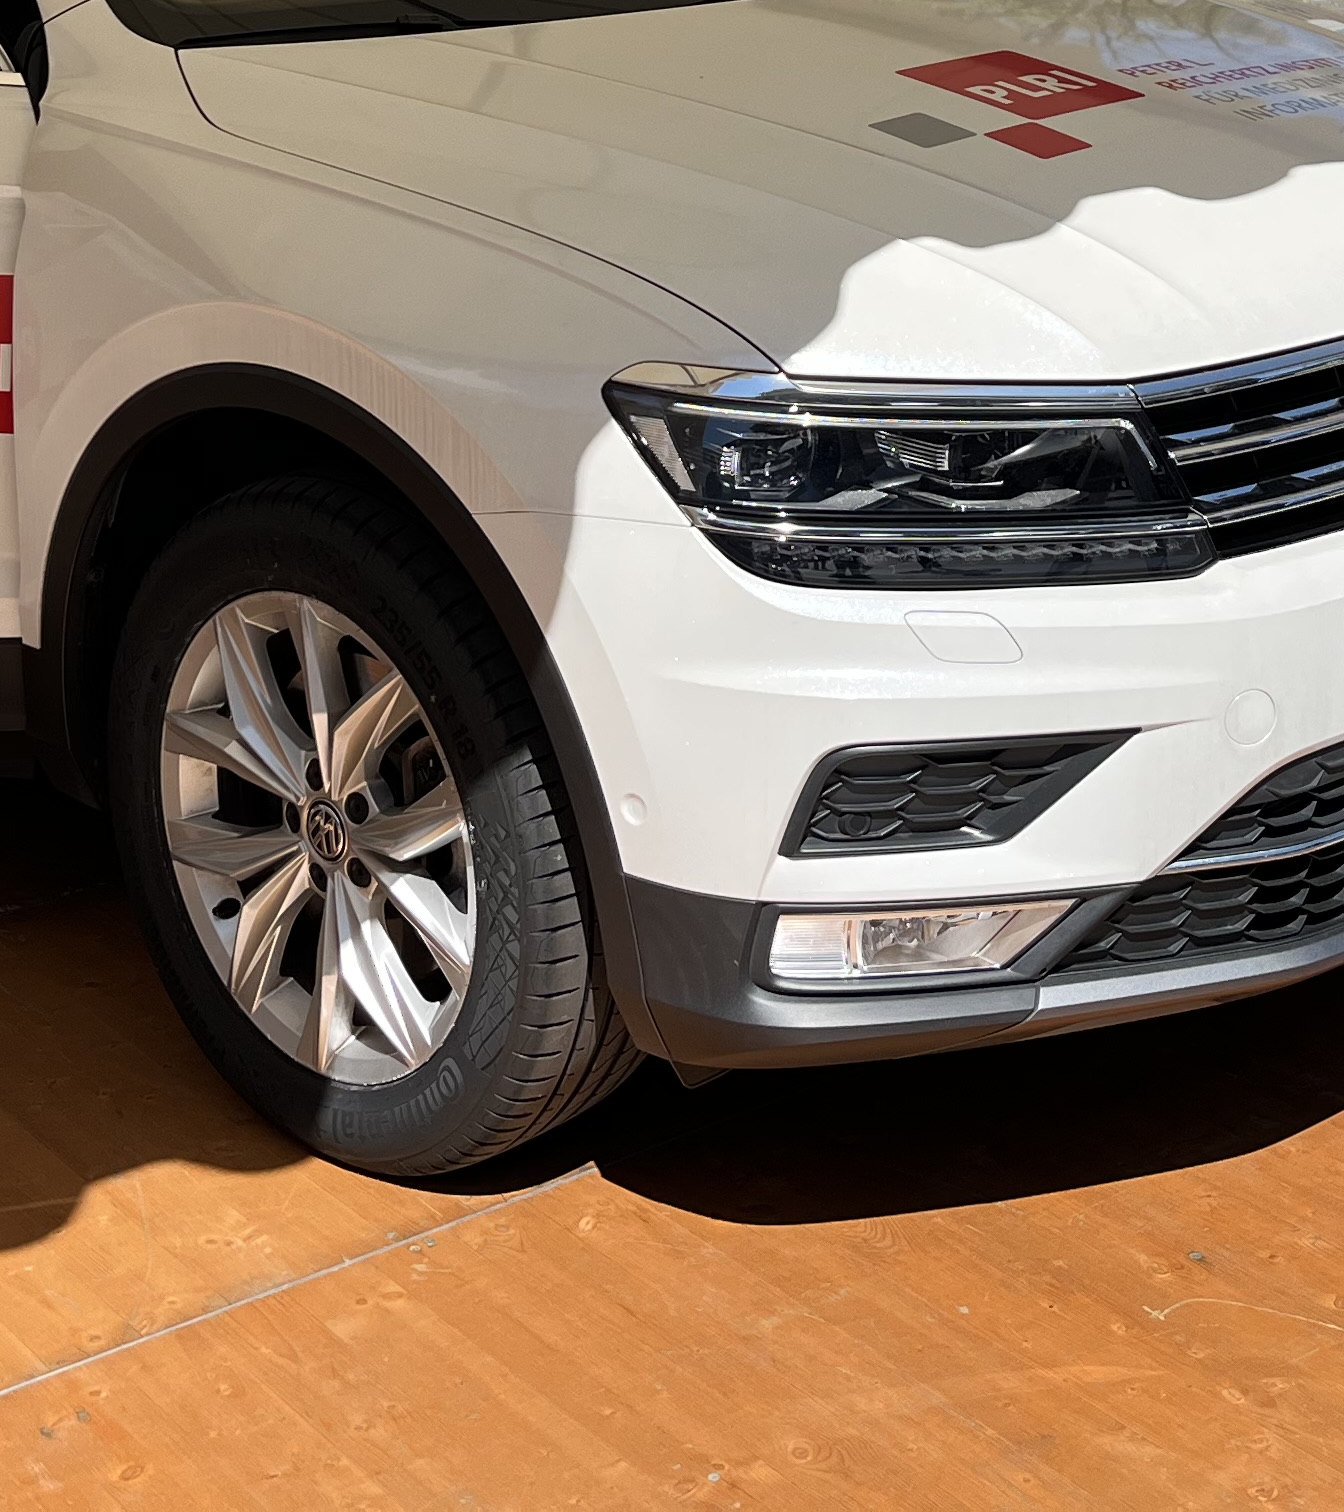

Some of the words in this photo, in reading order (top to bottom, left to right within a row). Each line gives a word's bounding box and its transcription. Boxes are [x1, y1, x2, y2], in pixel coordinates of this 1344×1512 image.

[1116, 58, 1191, 78] PETER
[1154, 64, 1274, 92] REICHERTZ
[962, 68, 1098, 106] PLRI
[1192, 86, 1253, 106] FÜR
